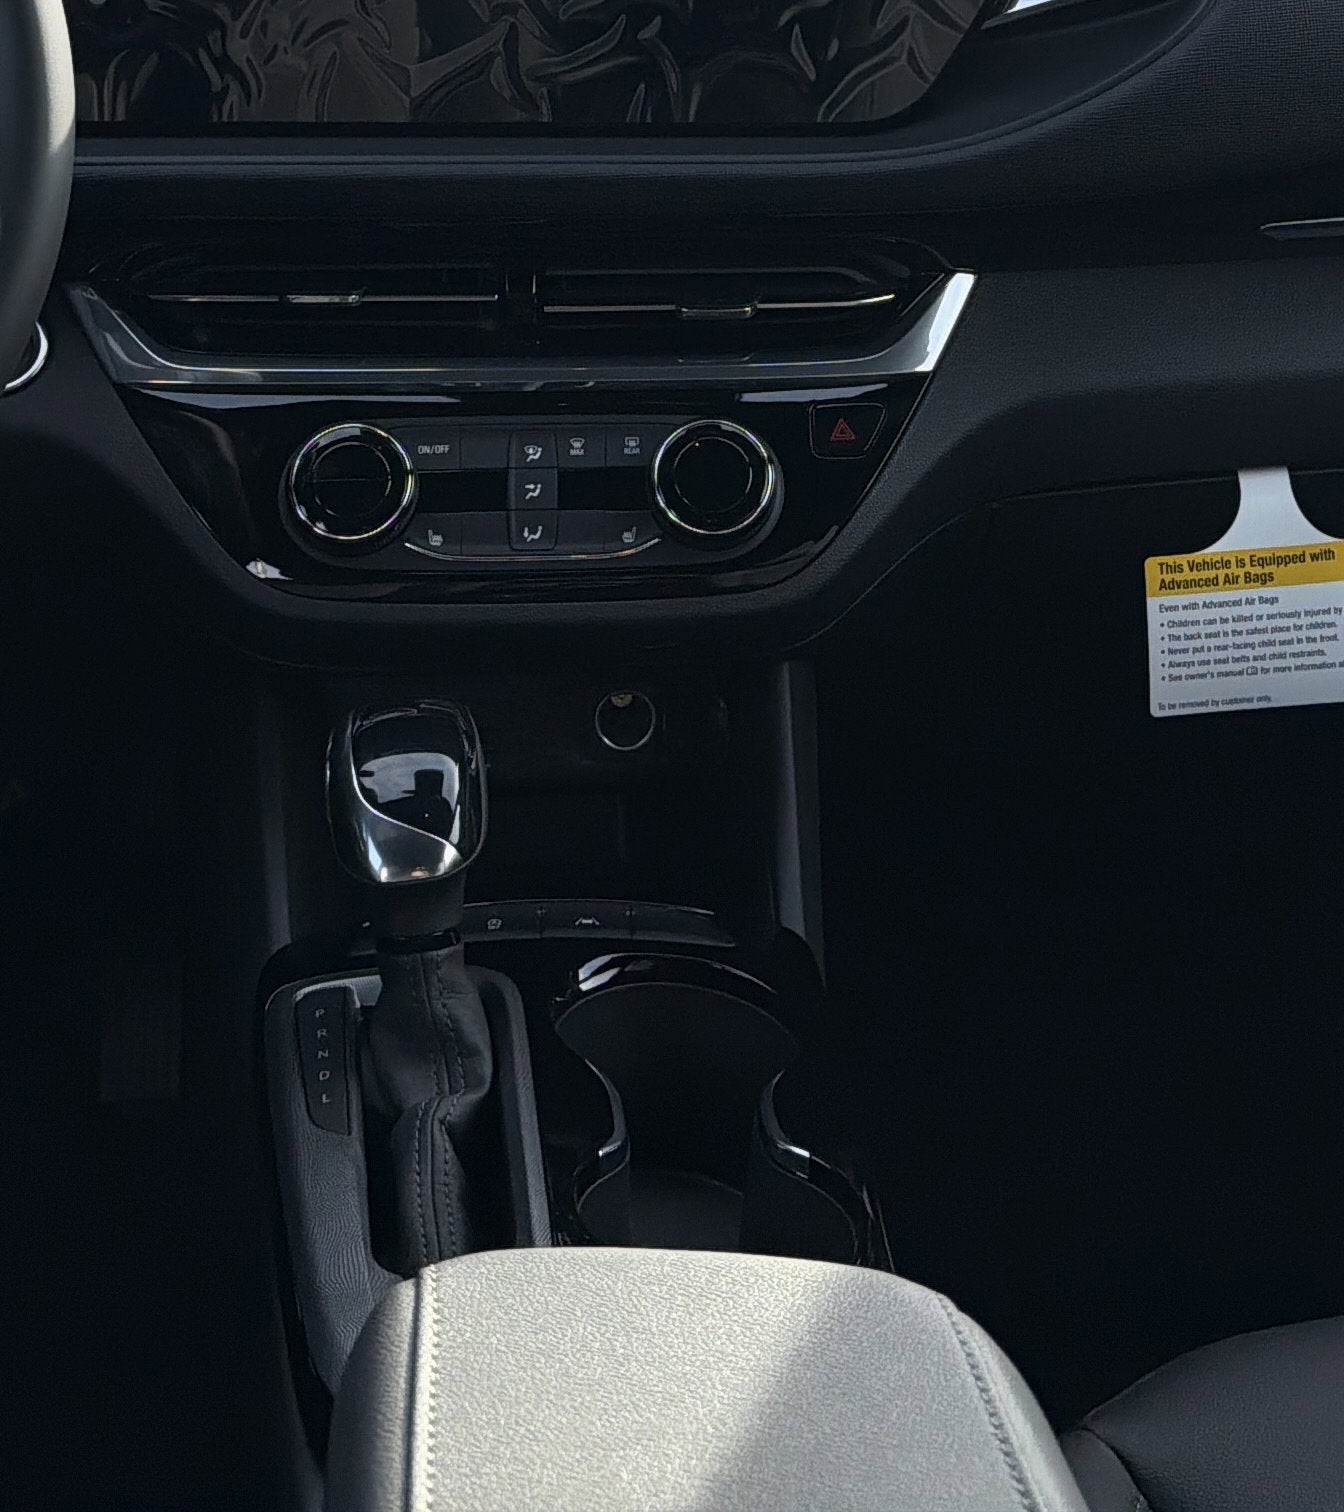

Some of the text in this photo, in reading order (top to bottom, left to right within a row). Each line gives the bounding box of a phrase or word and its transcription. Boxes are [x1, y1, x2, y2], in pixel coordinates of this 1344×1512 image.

[417, 444, 450, 455] ON/OFF
[1158, 547, 1334, 575] This Vehicle is Equipped with
[1158, 569, 1274, 591] Advanced Air Bags
[1159, 595, 1278, 612] Even with Advanced Air Bags
[1167, 618, 1200, 628] Children
[1232, 614, 1252, 622] killed
[1266, 609, 1301, 621] seriously
[1304, 607, 1330, 617] injured
[1333, 606, 1342, 615] by
[1167, 633, 1181, 641] The
[1183, 632, 1201, 640] back
[1245, 626, 1268, 634] safest
[1270, 624, 1290, 634] place
[1305, 620, 1337, 629] children.
[1167, 646, 1189, 654] Never
[1192, 645, 1204, 654] put
[1213, 641, 1255, 652] rear-facing
[1258, 639, 1275, 647] child
[1278, 637, 1293, 645] seat
[1319, 633, 1338, 641] front.
[1168, 659, 1194, 669] Always
[1252, 653, 1265, 661] and
[1268, 651, 1286, 659] child
[1288, 648, 1326, 658] restraints.
[1168, 673, 1182, 681] See
[1184, 671, 1215, 679] owner's
[1216, 668, 1244, 677] manual
[1294, 661, 1336, 670] information
